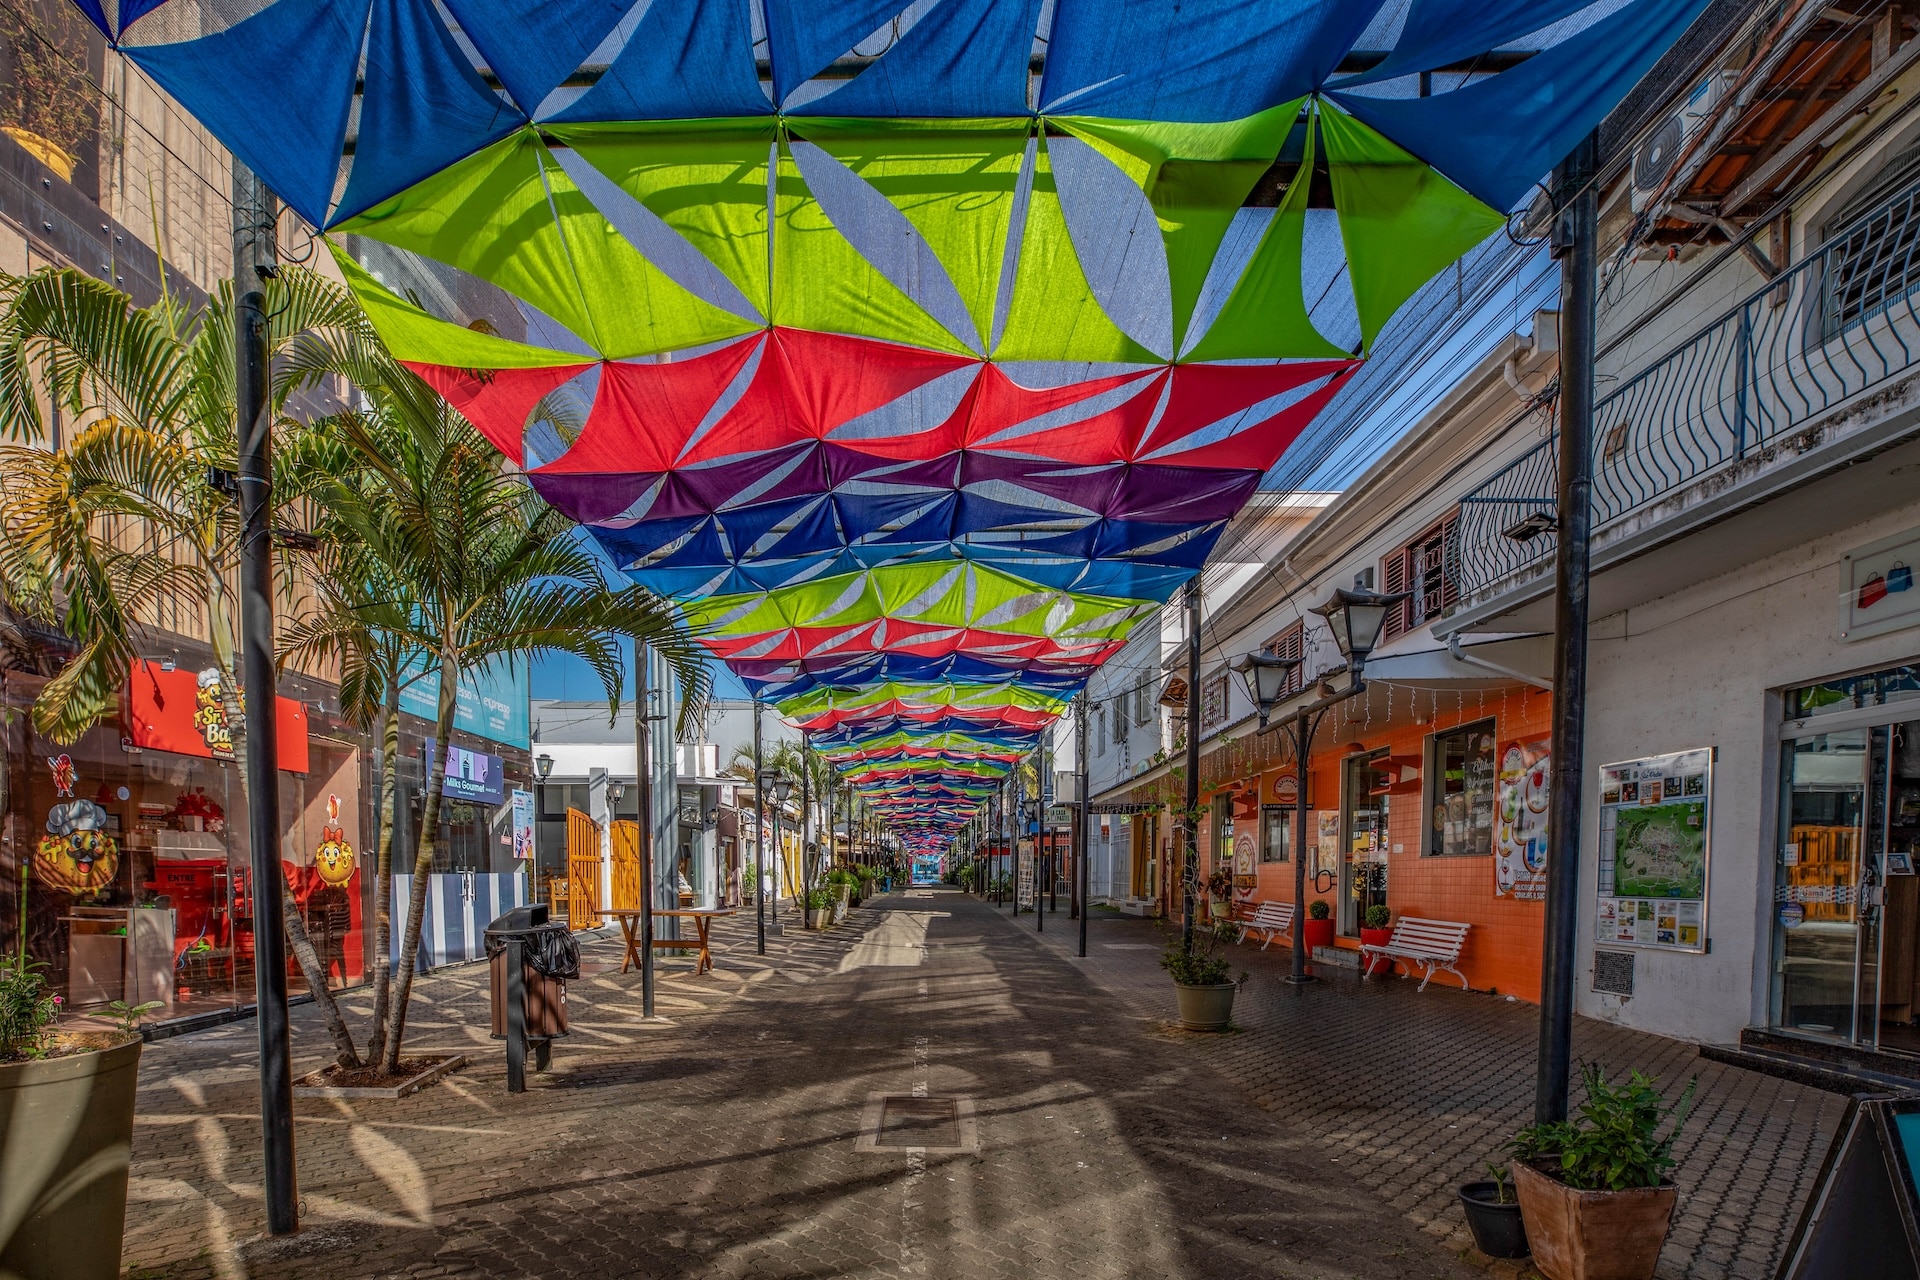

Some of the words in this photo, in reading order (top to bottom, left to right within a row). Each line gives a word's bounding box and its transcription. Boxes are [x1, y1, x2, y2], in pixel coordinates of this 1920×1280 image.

[483, 696, 511, 714] expresso
[202, 706, 222, 724] Sr.
[446, 777, 461, 789] Milks
[461, 780, 485, 793] Gourmet
[167, 874, 196, 883] ENTRE
[1802, 890, 1824, 898] Gama
